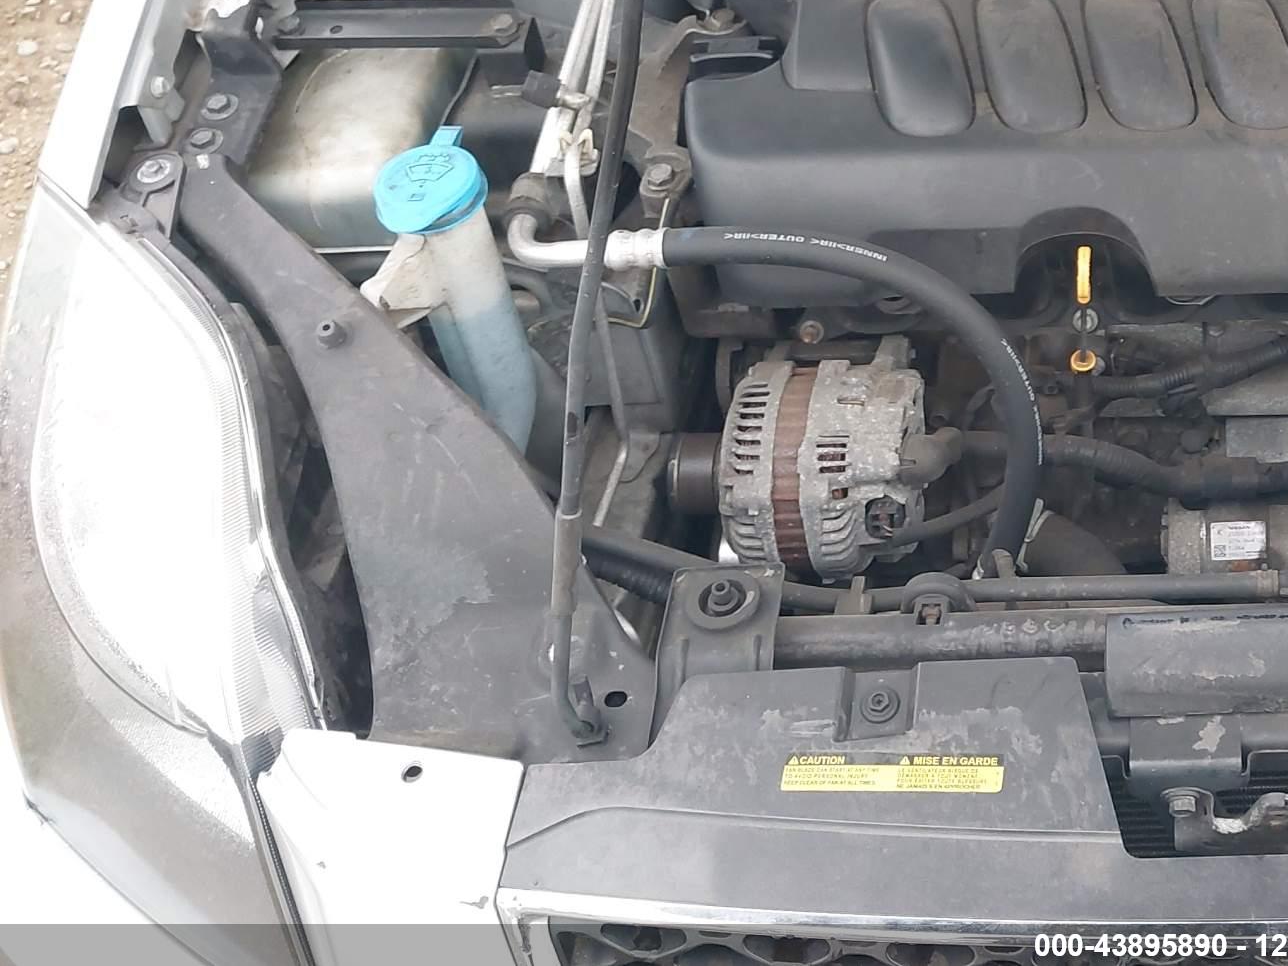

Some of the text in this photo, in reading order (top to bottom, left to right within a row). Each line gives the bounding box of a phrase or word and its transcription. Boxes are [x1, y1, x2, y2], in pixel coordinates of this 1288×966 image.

[799, 755, 846, 765] CAUTION
[913, 756, 999, 766] MISE EN GARDE
